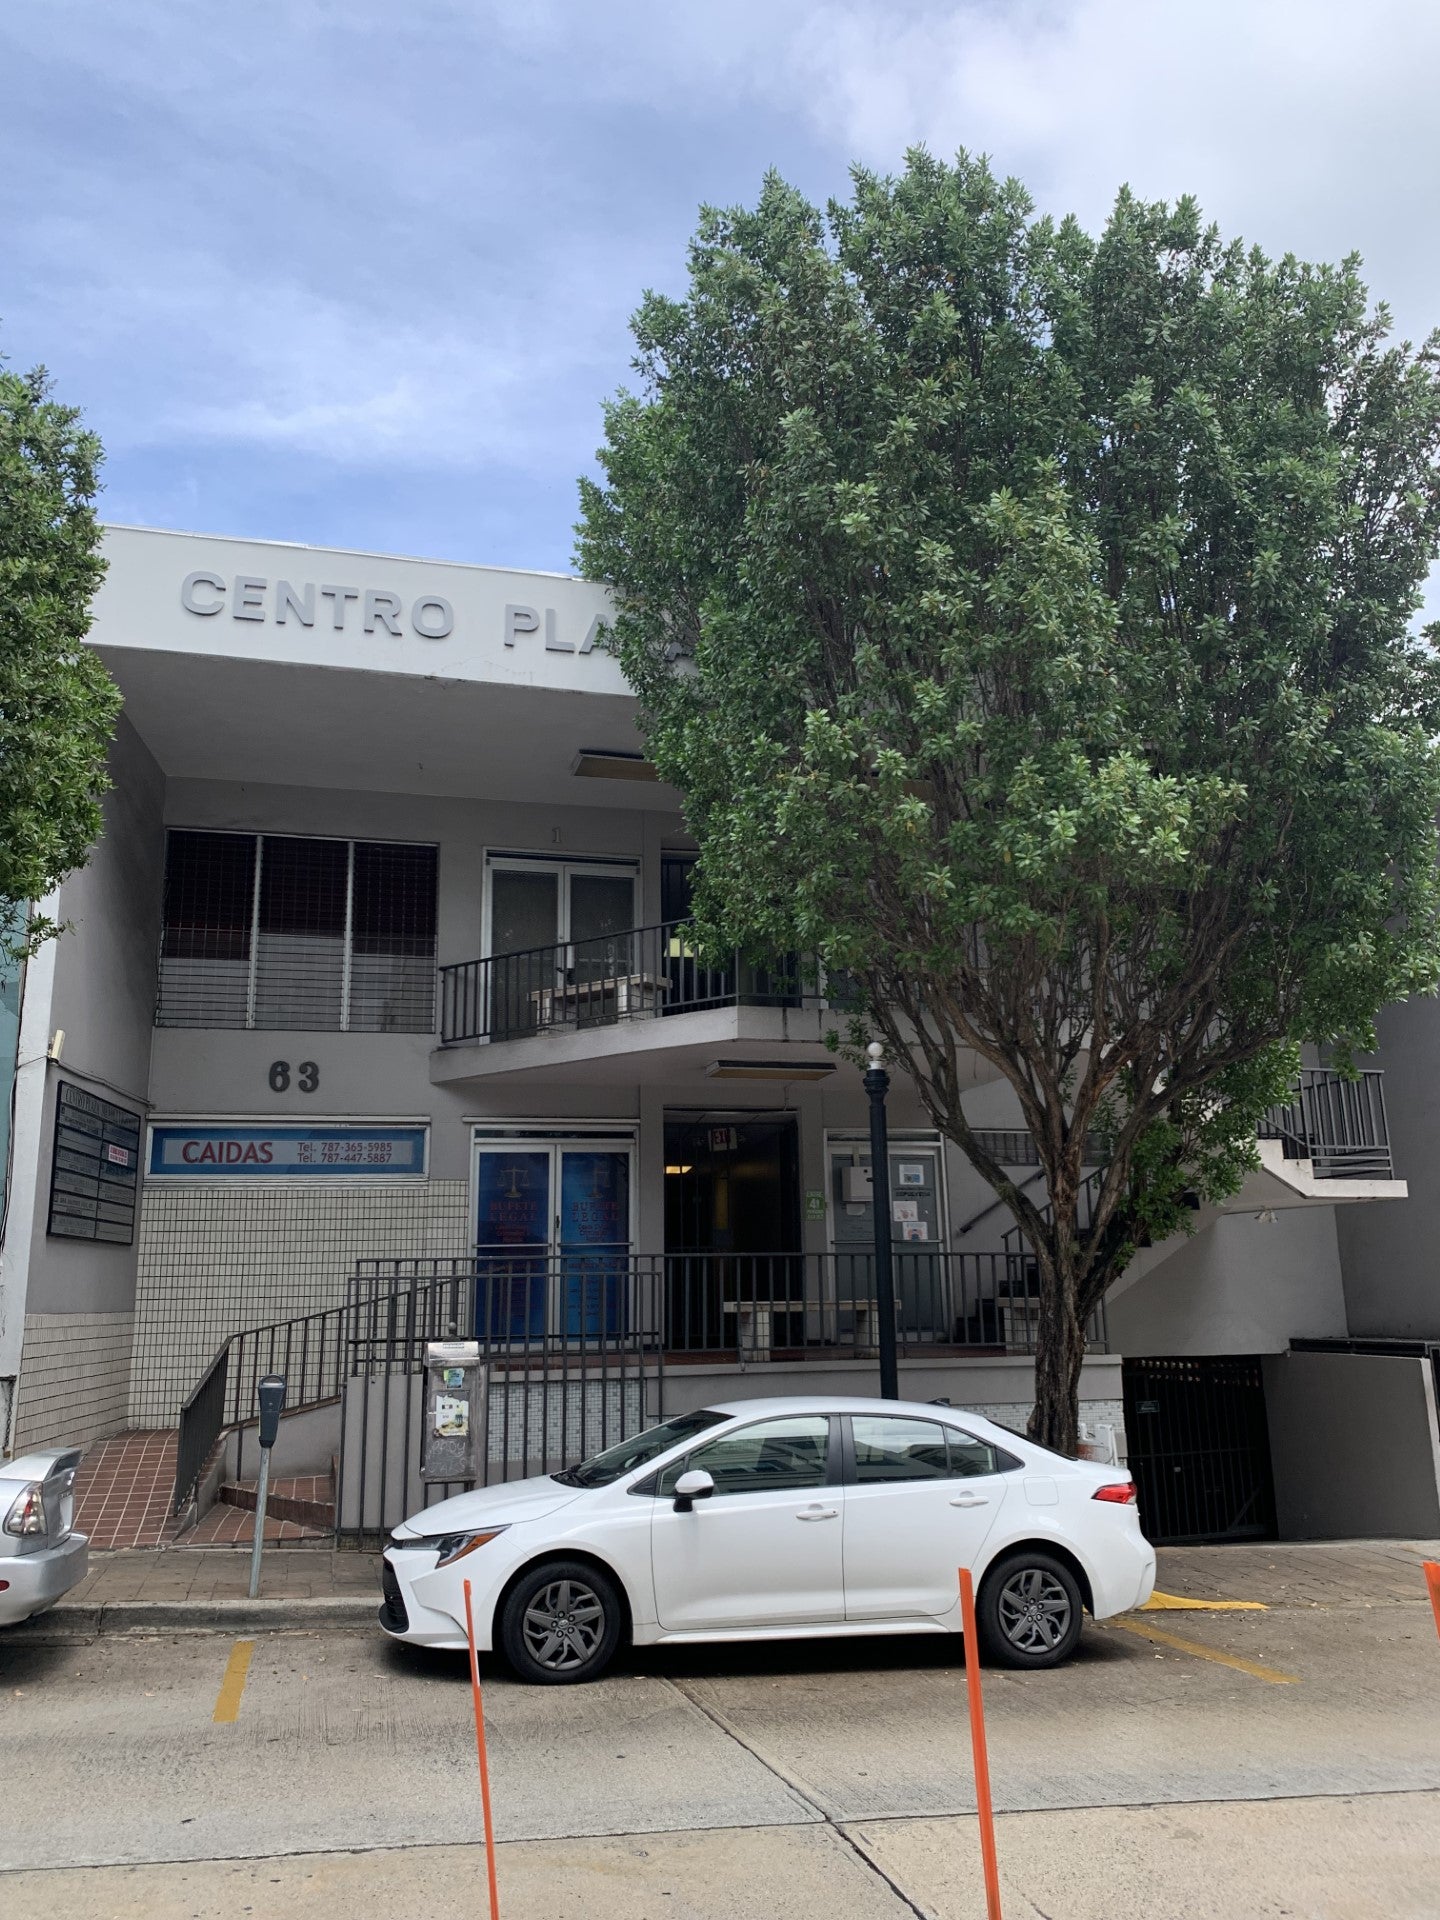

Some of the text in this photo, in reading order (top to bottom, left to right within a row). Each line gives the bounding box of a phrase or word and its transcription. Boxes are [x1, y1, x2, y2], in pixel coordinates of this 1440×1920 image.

[181, 570, 455, 639] CENTRO
[268, 1060, 320, 1093] 63
[182, 1141, 274, 1164] CAIDAS
[297, 1142, 393, 1152] Tel. 787-365-5985
[297, 1153, 393, 1163] Tel. 787-447-5887
